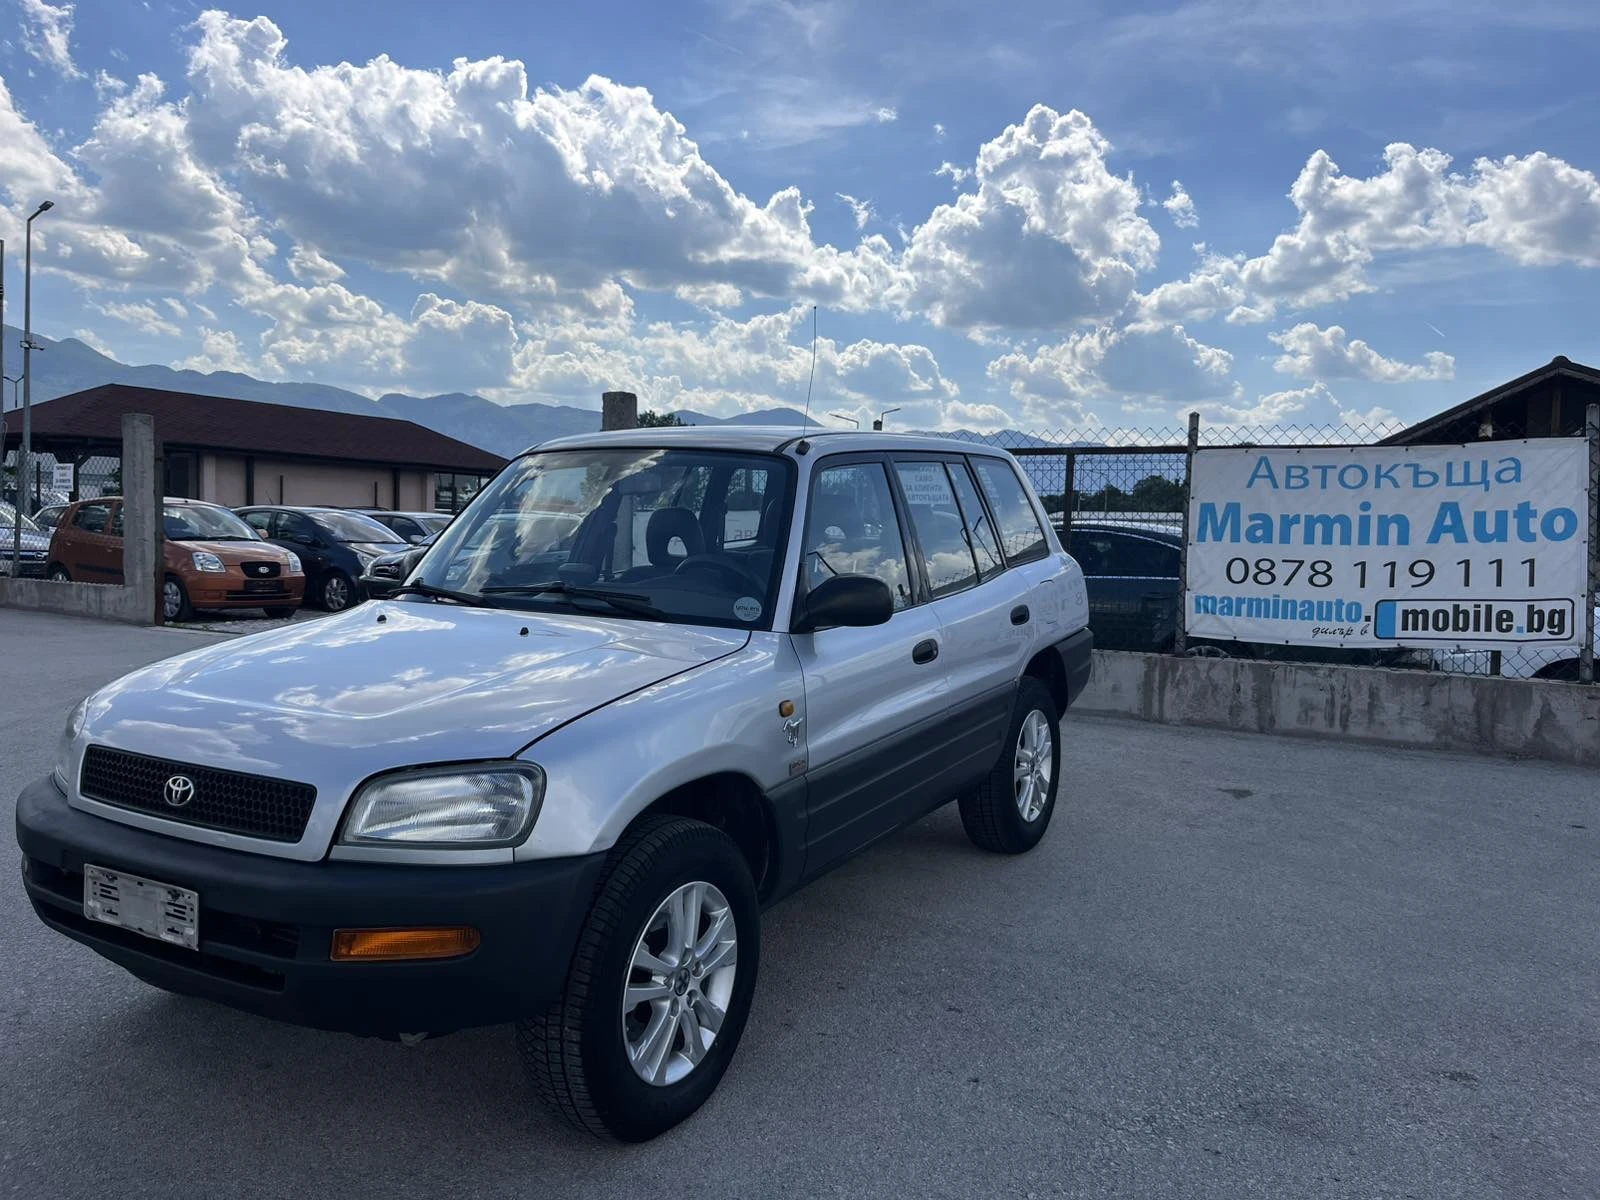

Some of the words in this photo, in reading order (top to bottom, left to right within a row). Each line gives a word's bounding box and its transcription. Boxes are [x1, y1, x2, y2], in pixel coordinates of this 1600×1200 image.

[1246, 456, 1522, 492] Автокъща
[1196, 501, 1411, 546] Marmin
[1426, 501, 1578, 543] Auto
[1225, 557, 1333, 588] 0878
[1353, 559, 1436, 588] 119
[1456, 558, 1536, 588] 111
[1401, 604, 1566, 636] mobile.bg
